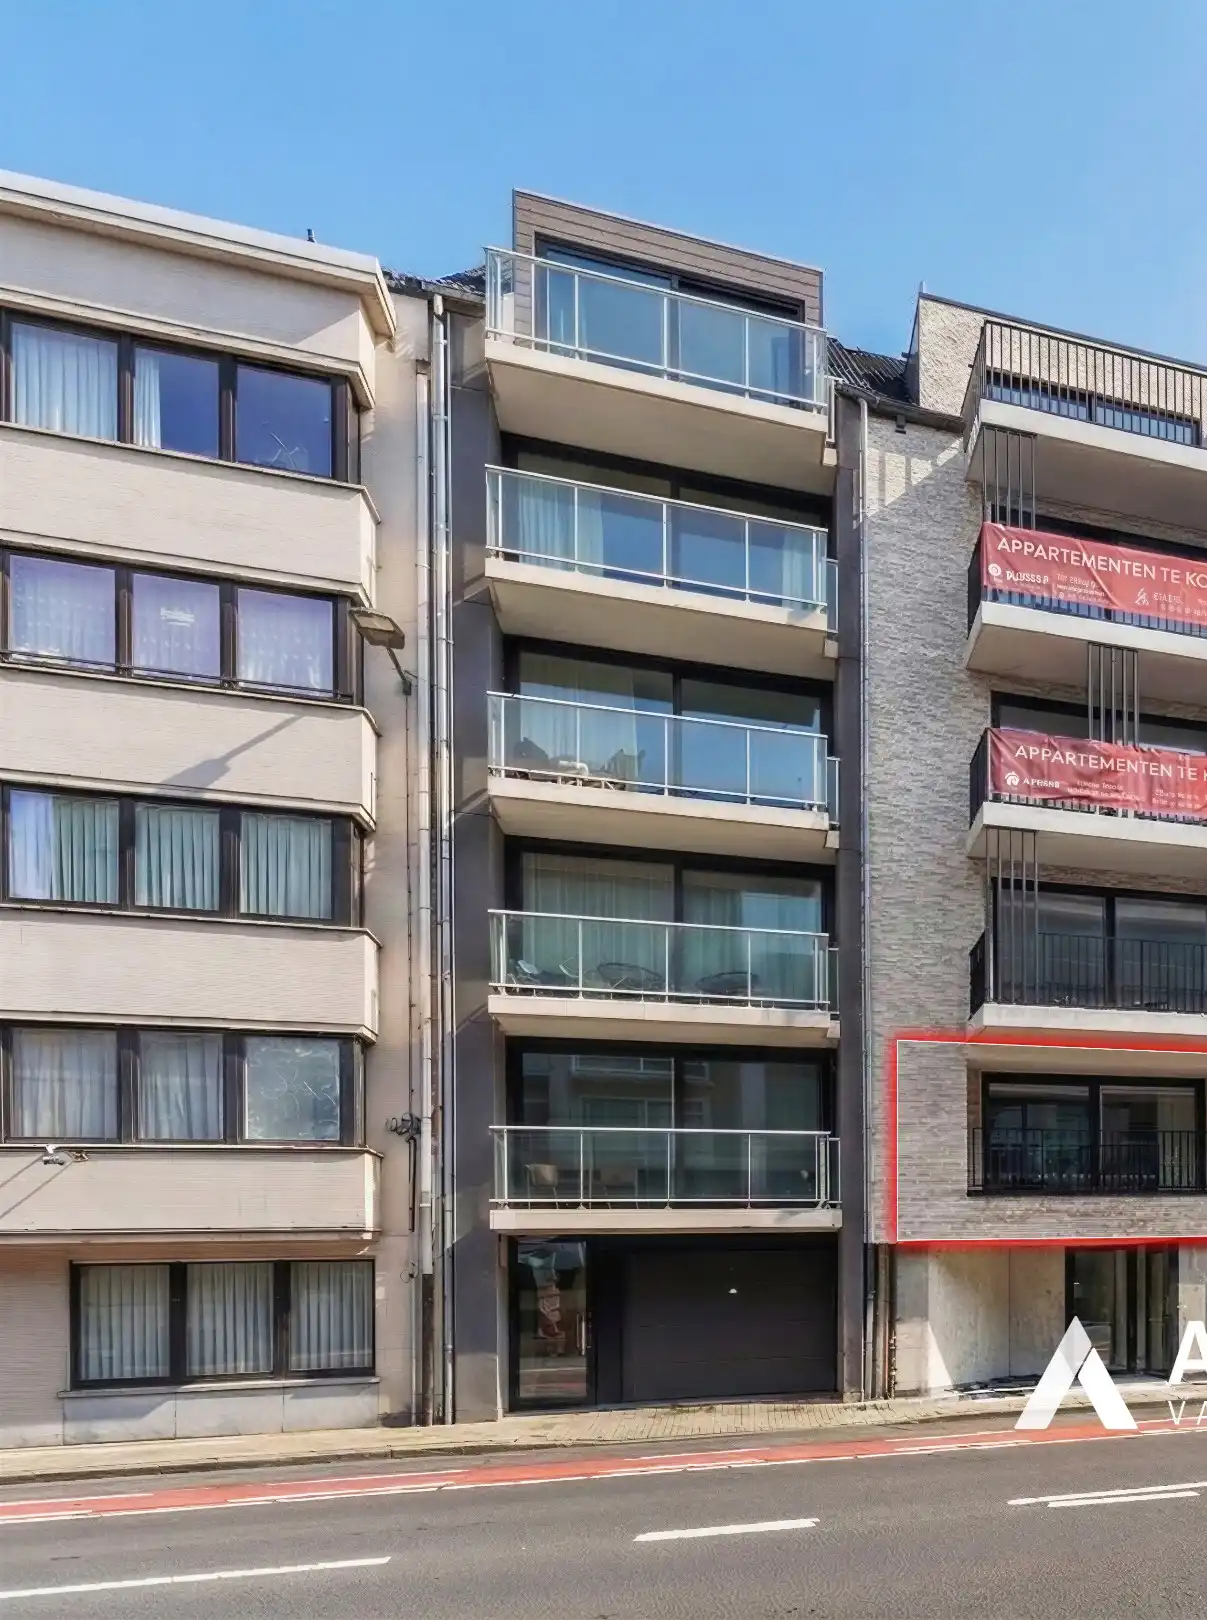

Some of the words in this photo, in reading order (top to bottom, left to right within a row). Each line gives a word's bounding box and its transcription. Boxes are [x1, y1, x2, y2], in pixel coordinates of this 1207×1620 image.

[997, 537, 1156, 581] APPARTEMENTEN
[1160, 567, 1181, 584] TE
[1014, 744, 1173, 777] APPARTEMENTEN
[1177, 766, 1198, 781] TE
